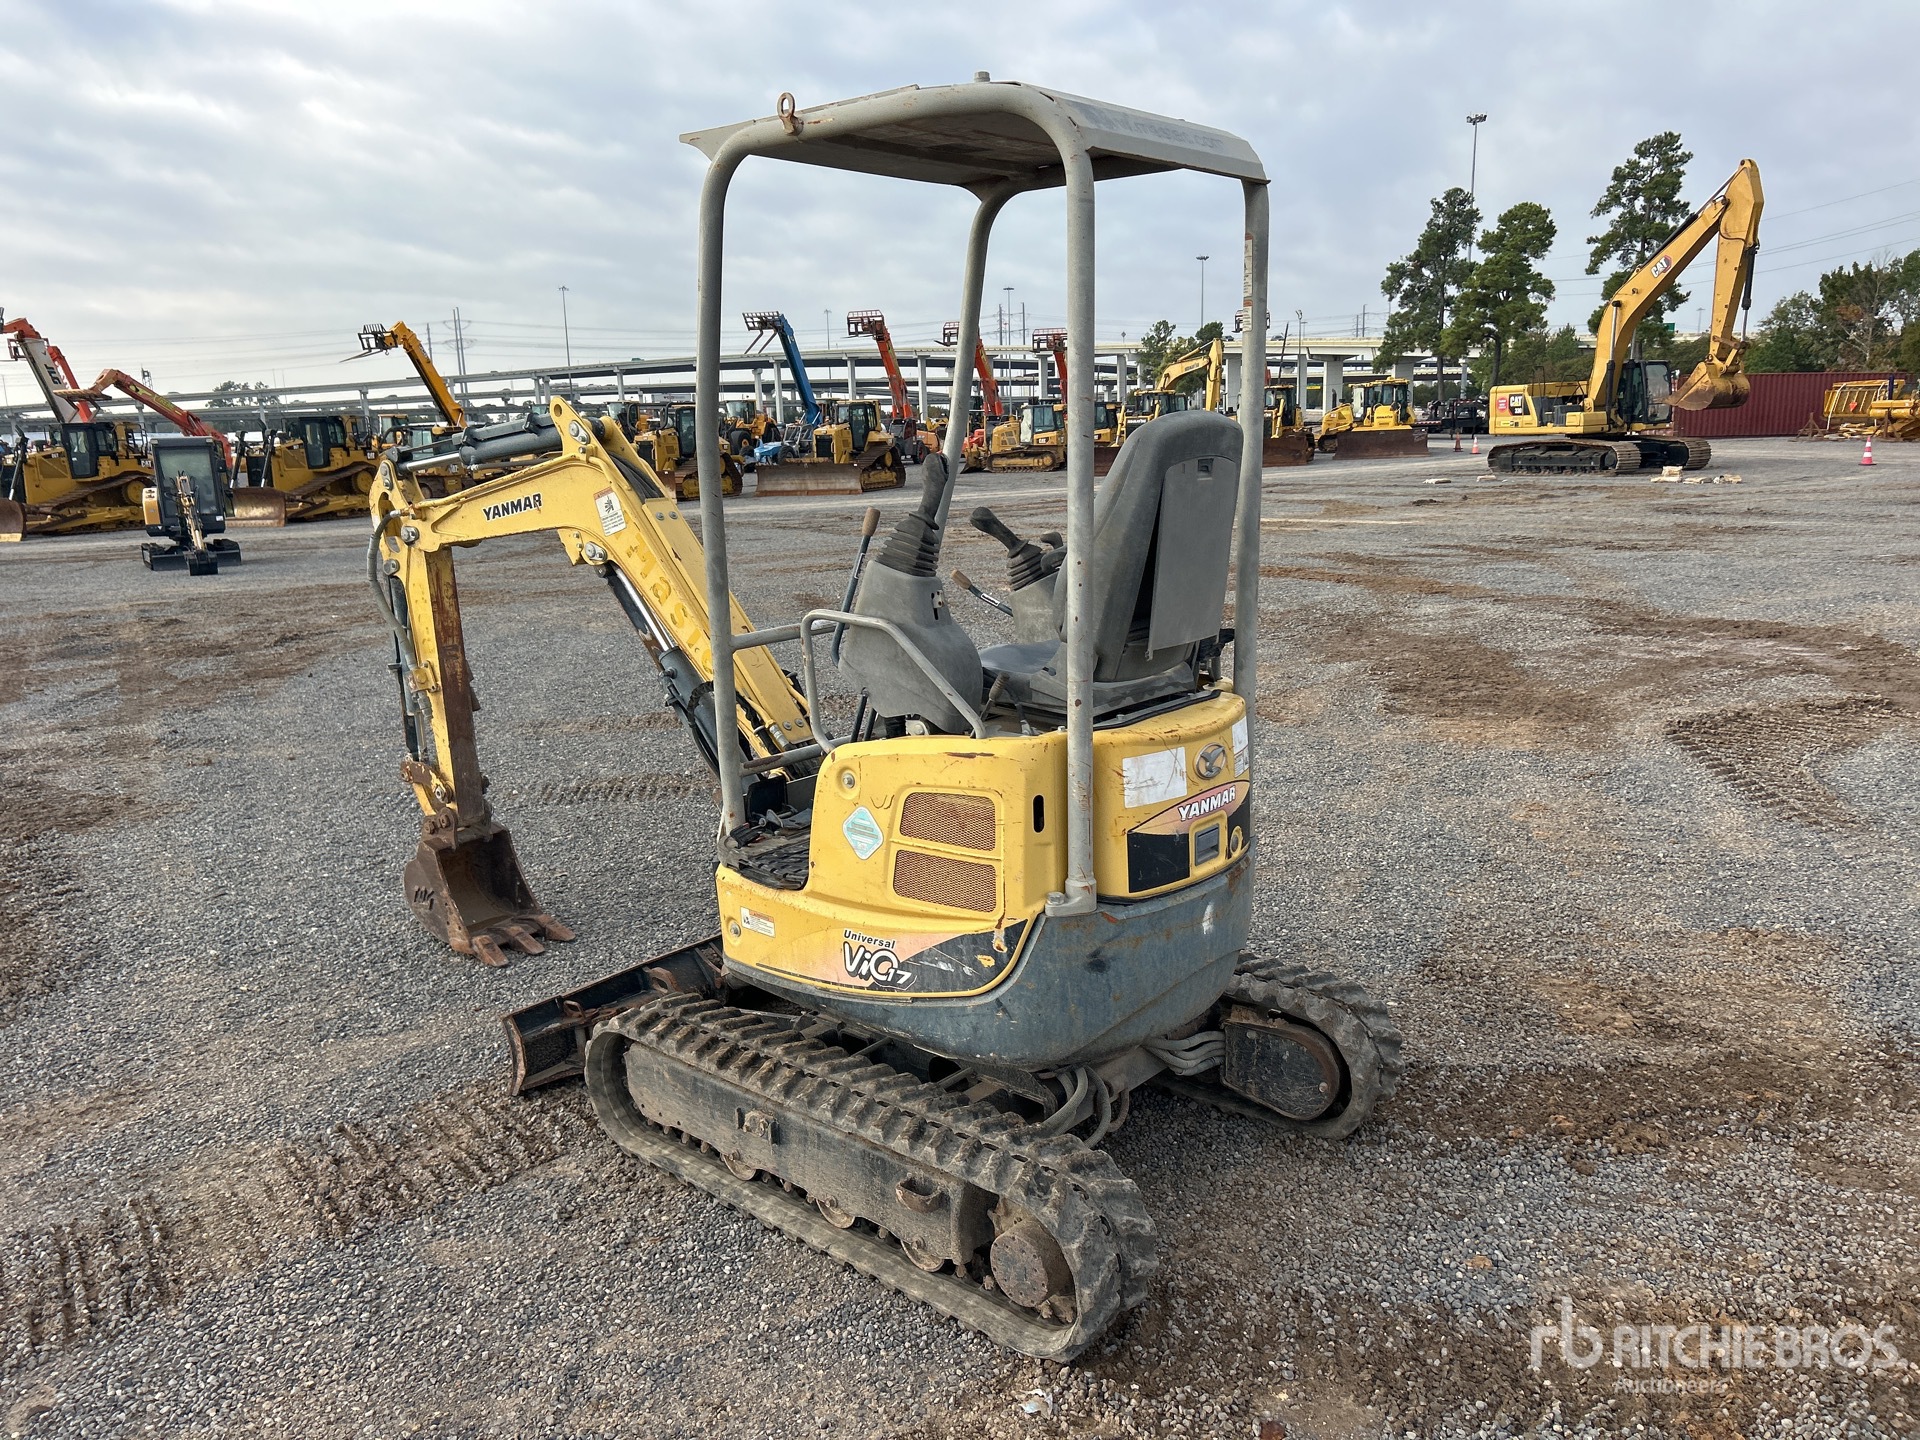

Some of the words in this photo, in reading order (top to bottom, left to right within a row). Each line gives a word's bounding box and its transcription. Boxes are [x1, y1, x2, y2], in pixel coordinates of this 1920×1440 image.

[1651, 257, 1668, 278] CAT
[44, 364, 62, 385] JLG
[1510, 395, 1523, 407] CAT
[482, 493, 543, 521] YANMAR
[1178, 785, 1236, 821] YANMAR
[843, 929, 896, 949] Universal
